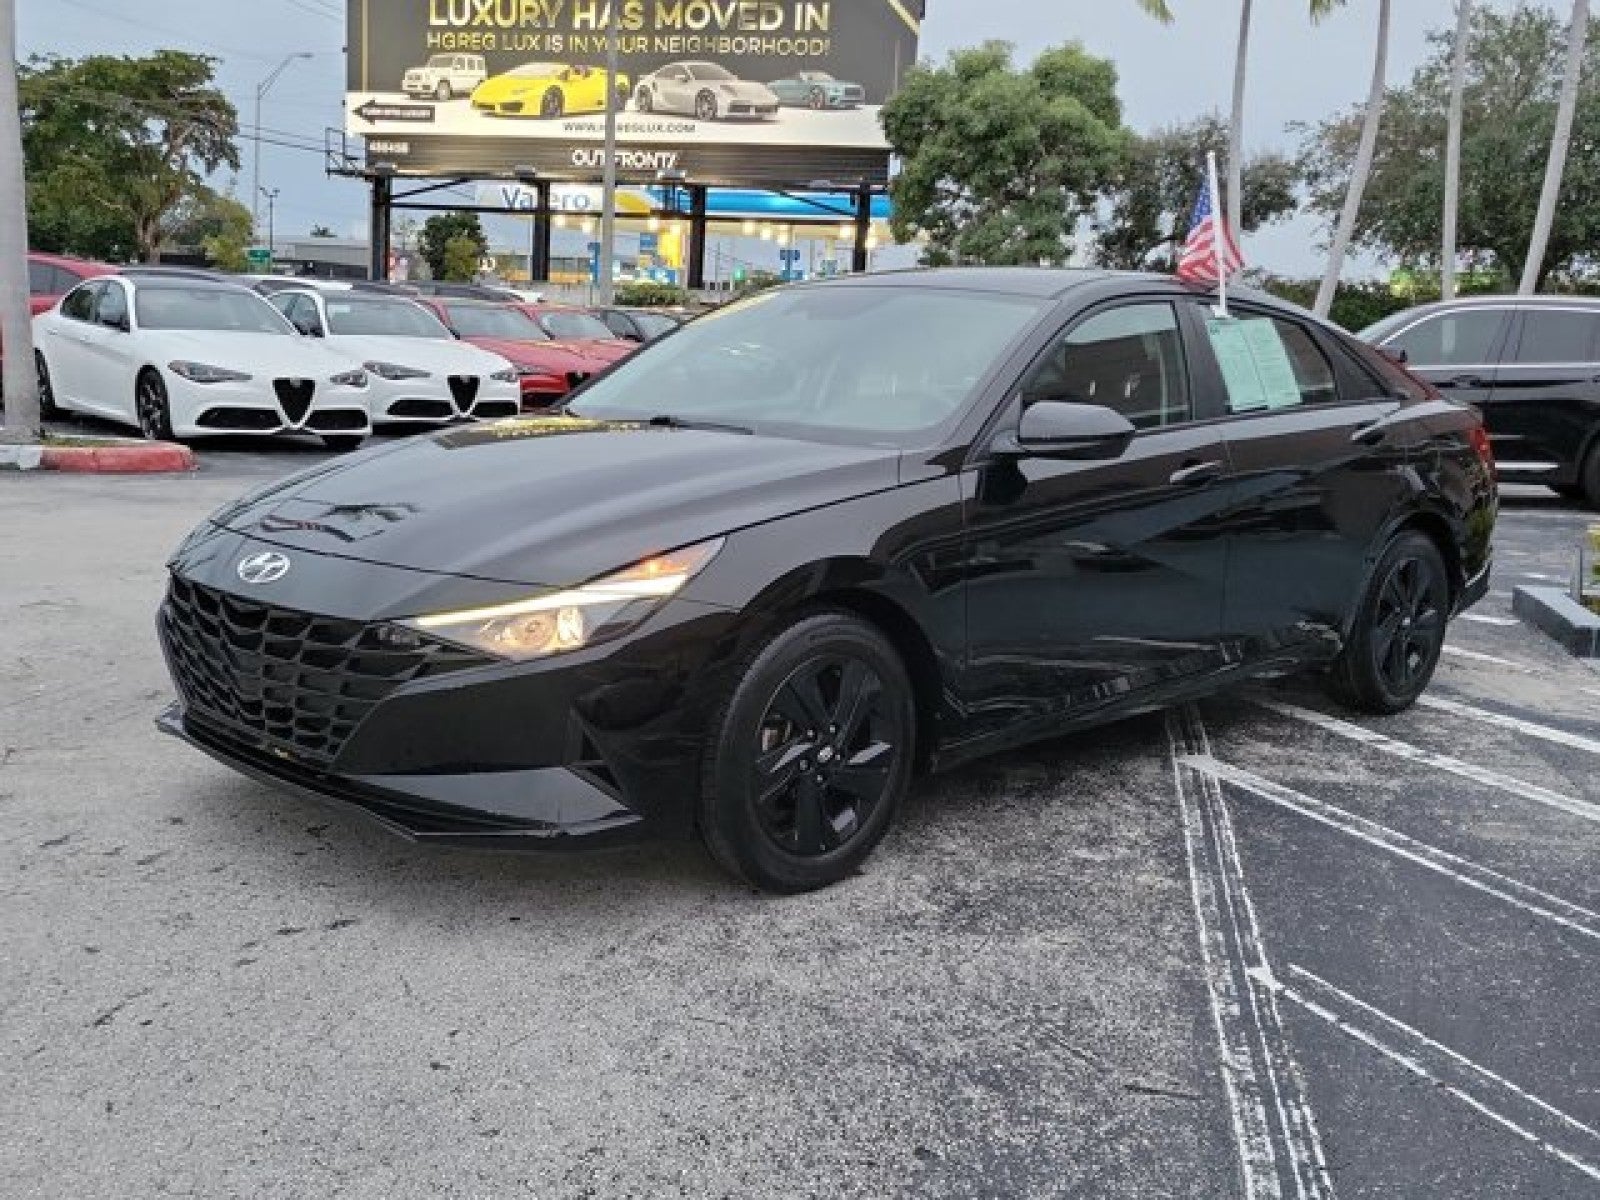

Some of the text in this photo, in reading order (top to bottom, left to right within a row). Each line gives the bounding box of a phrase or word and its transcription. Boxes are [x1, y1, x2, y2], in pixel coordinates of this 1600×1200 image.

[429, 0, 831, 31] LUXURY HAS MOVED IN
[427, 31, 496, 49] HGREG
[502, 34, 541, 51] LUX
[544, 34, 563, 52] IS
[569, 35, 589, 53] IN
[502, 186, 591, 210] Vaero
